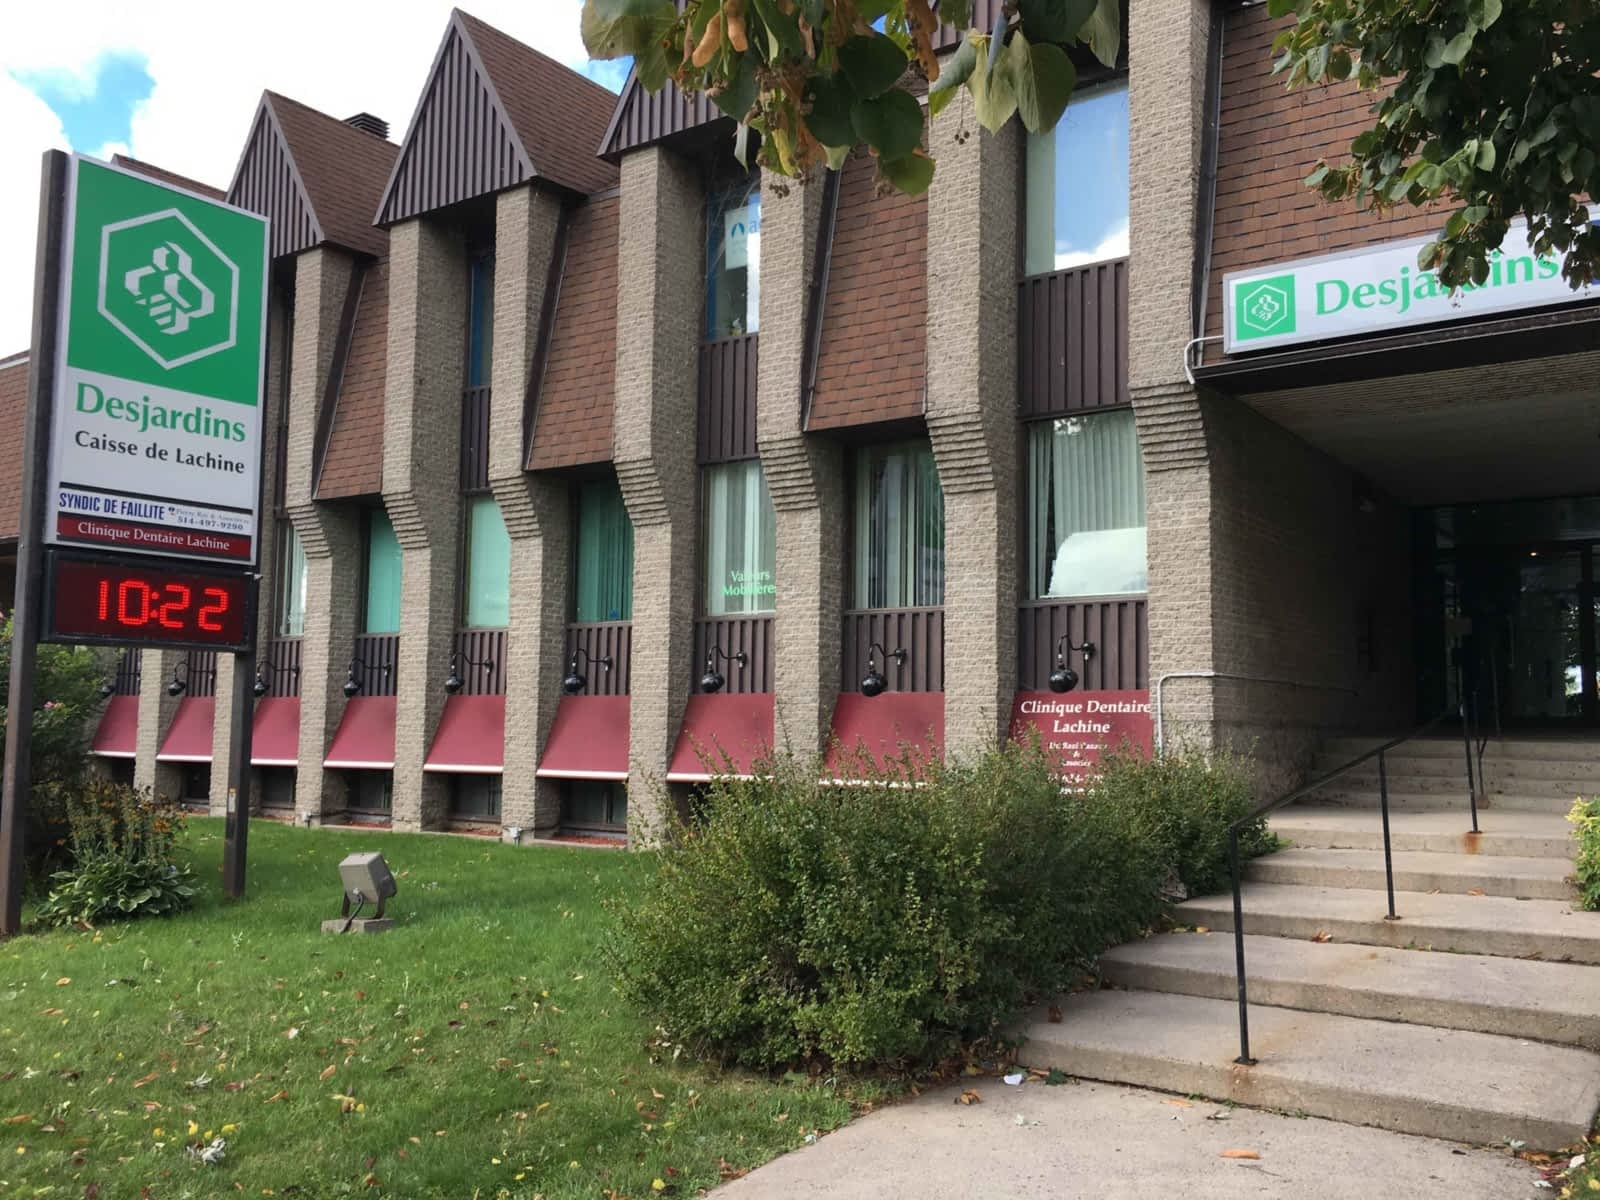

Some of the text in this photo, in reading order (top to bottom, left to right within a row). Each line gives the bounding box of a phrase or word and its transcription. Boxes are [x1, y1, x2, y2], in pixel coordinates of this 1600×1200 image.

[1316, 248, 1560, 314] Desjains
[76, 382, 246, 442] Desjardins
[75, 430, 245, 474] Caisse de Lachine
[59, 492, 101, 512] SYNDIC
[103, 498, 119, 514] DE
[121, 501, 165, 520] FAILLITE
[78, 522, 230, 551] Clinique Dentaire Lachine
[97, 579, 229, 631] 10:22
[1020, 700, 1152, 717] Clinique Dentaire
[1053, 719, 1111, 734] Lachine
